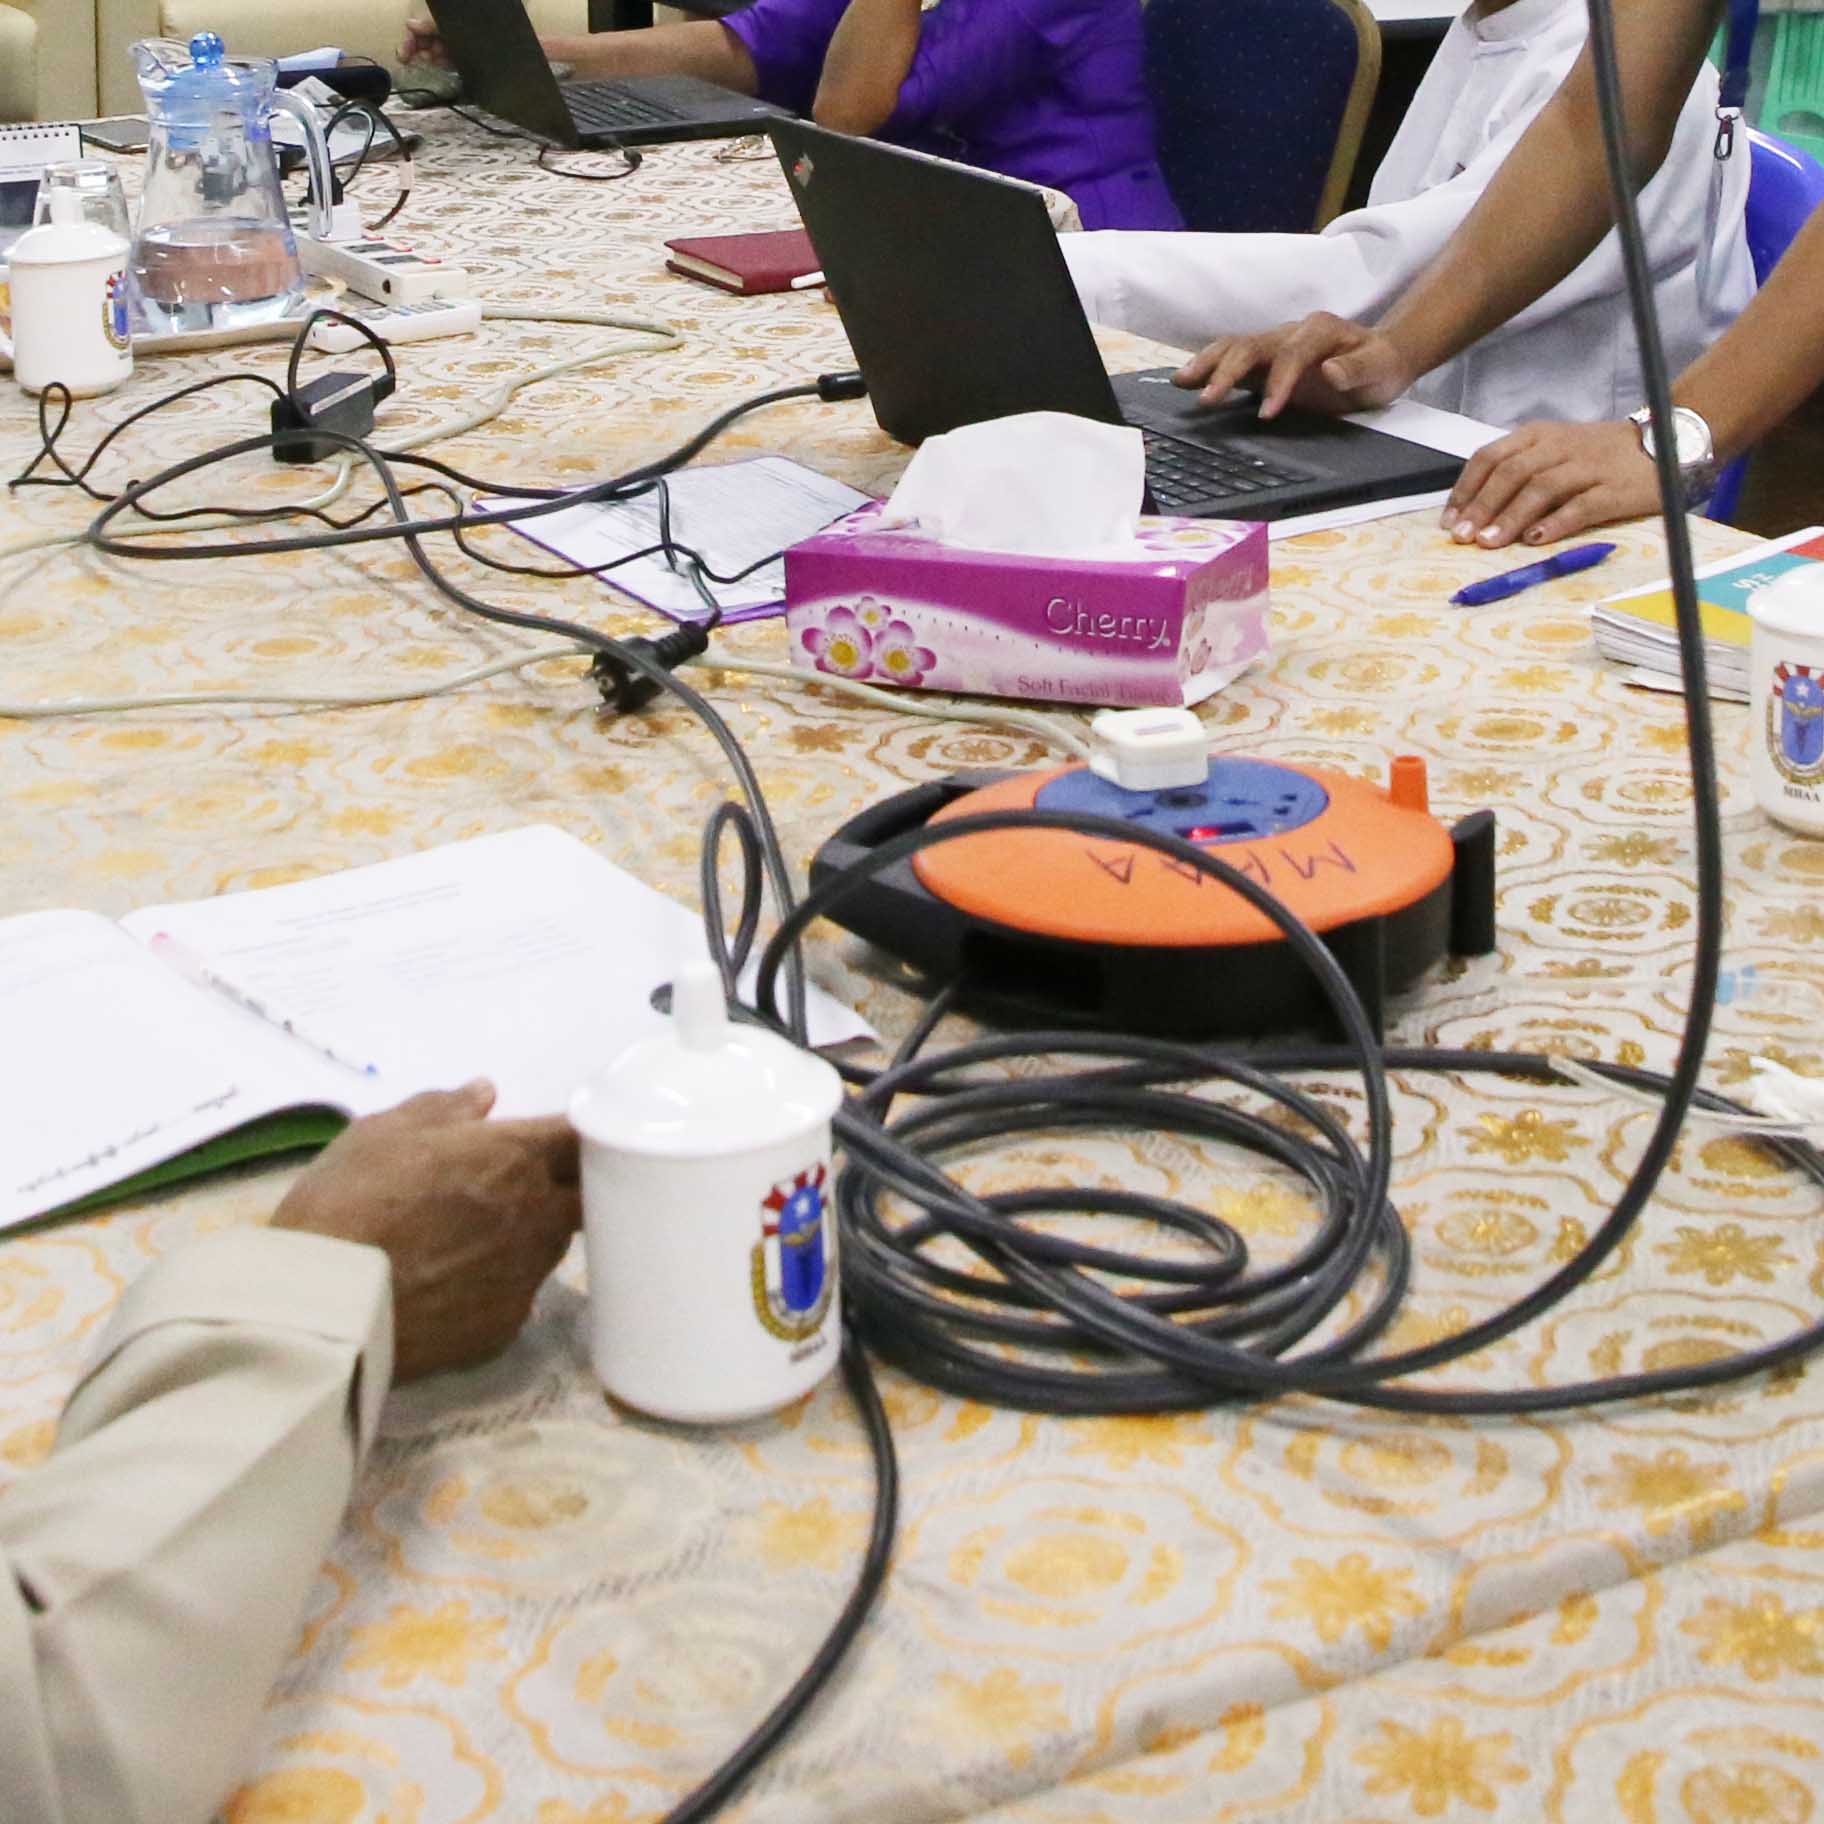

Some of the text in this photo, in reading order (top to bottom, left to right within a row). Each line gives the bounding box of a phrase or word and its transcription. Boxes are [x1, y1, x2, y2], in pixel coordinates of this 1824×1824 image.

[1047, 597, 1167, 650] Cherry
[1017, 676, 1053, 694] Soft
[1059, 679, 1110, 698] Facial
